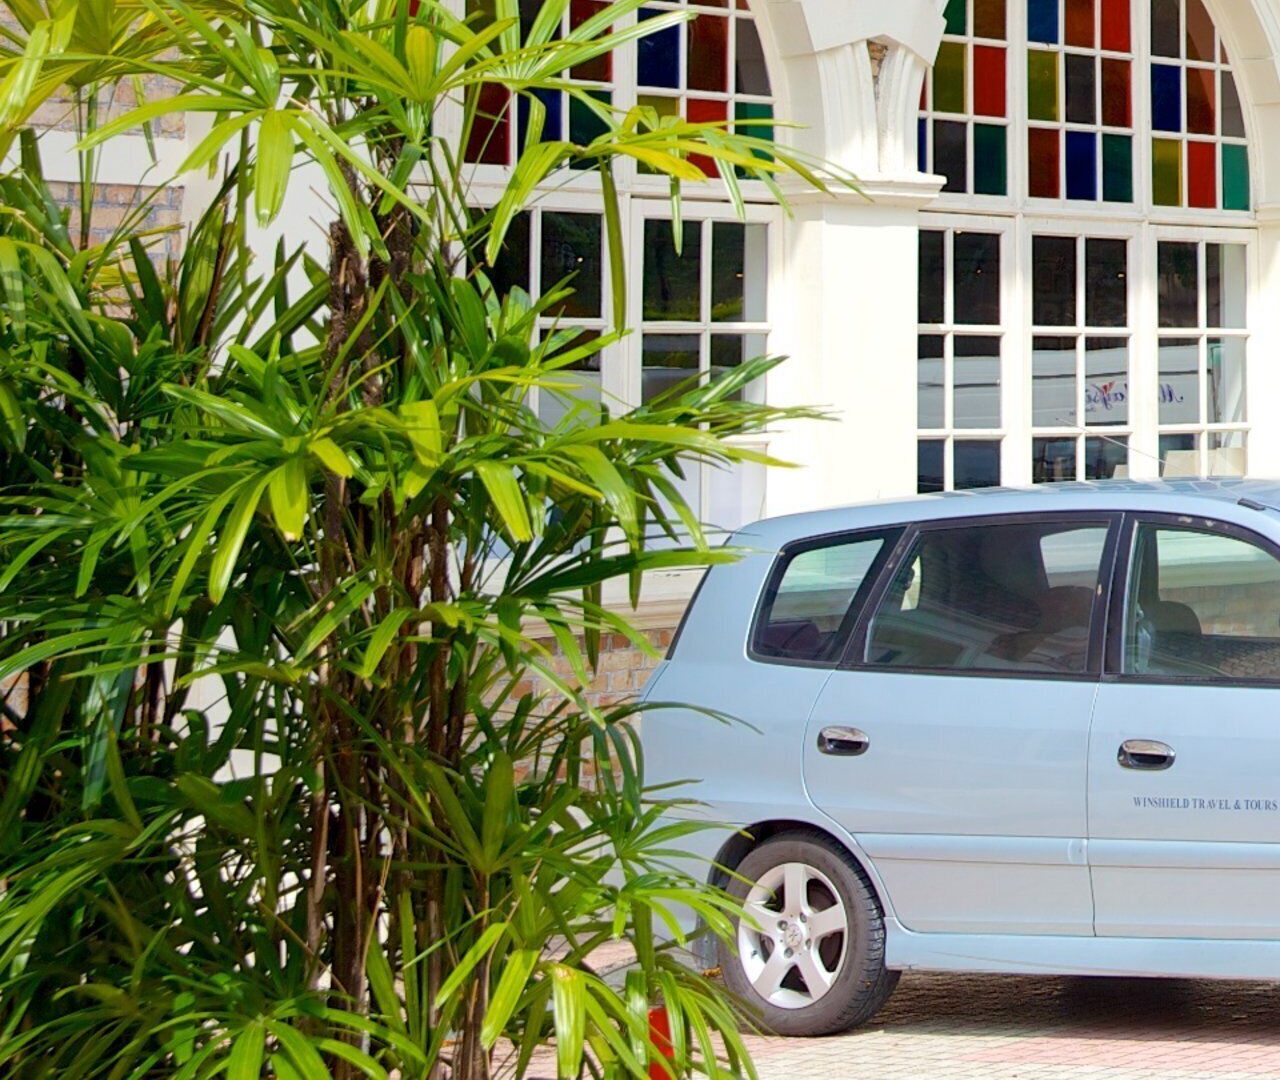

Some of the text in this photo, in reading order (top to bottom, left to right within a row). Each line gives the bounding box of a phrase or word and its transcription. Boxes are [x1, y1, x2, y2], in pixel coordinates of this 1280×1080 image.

[1133, 796, 1190, 809] WINSHIELD
[1192, 798, 1231, 810] TRAVEL
[1233, 799, 1242, 810] &
[1244, 799, 1278, 811] TOURS
